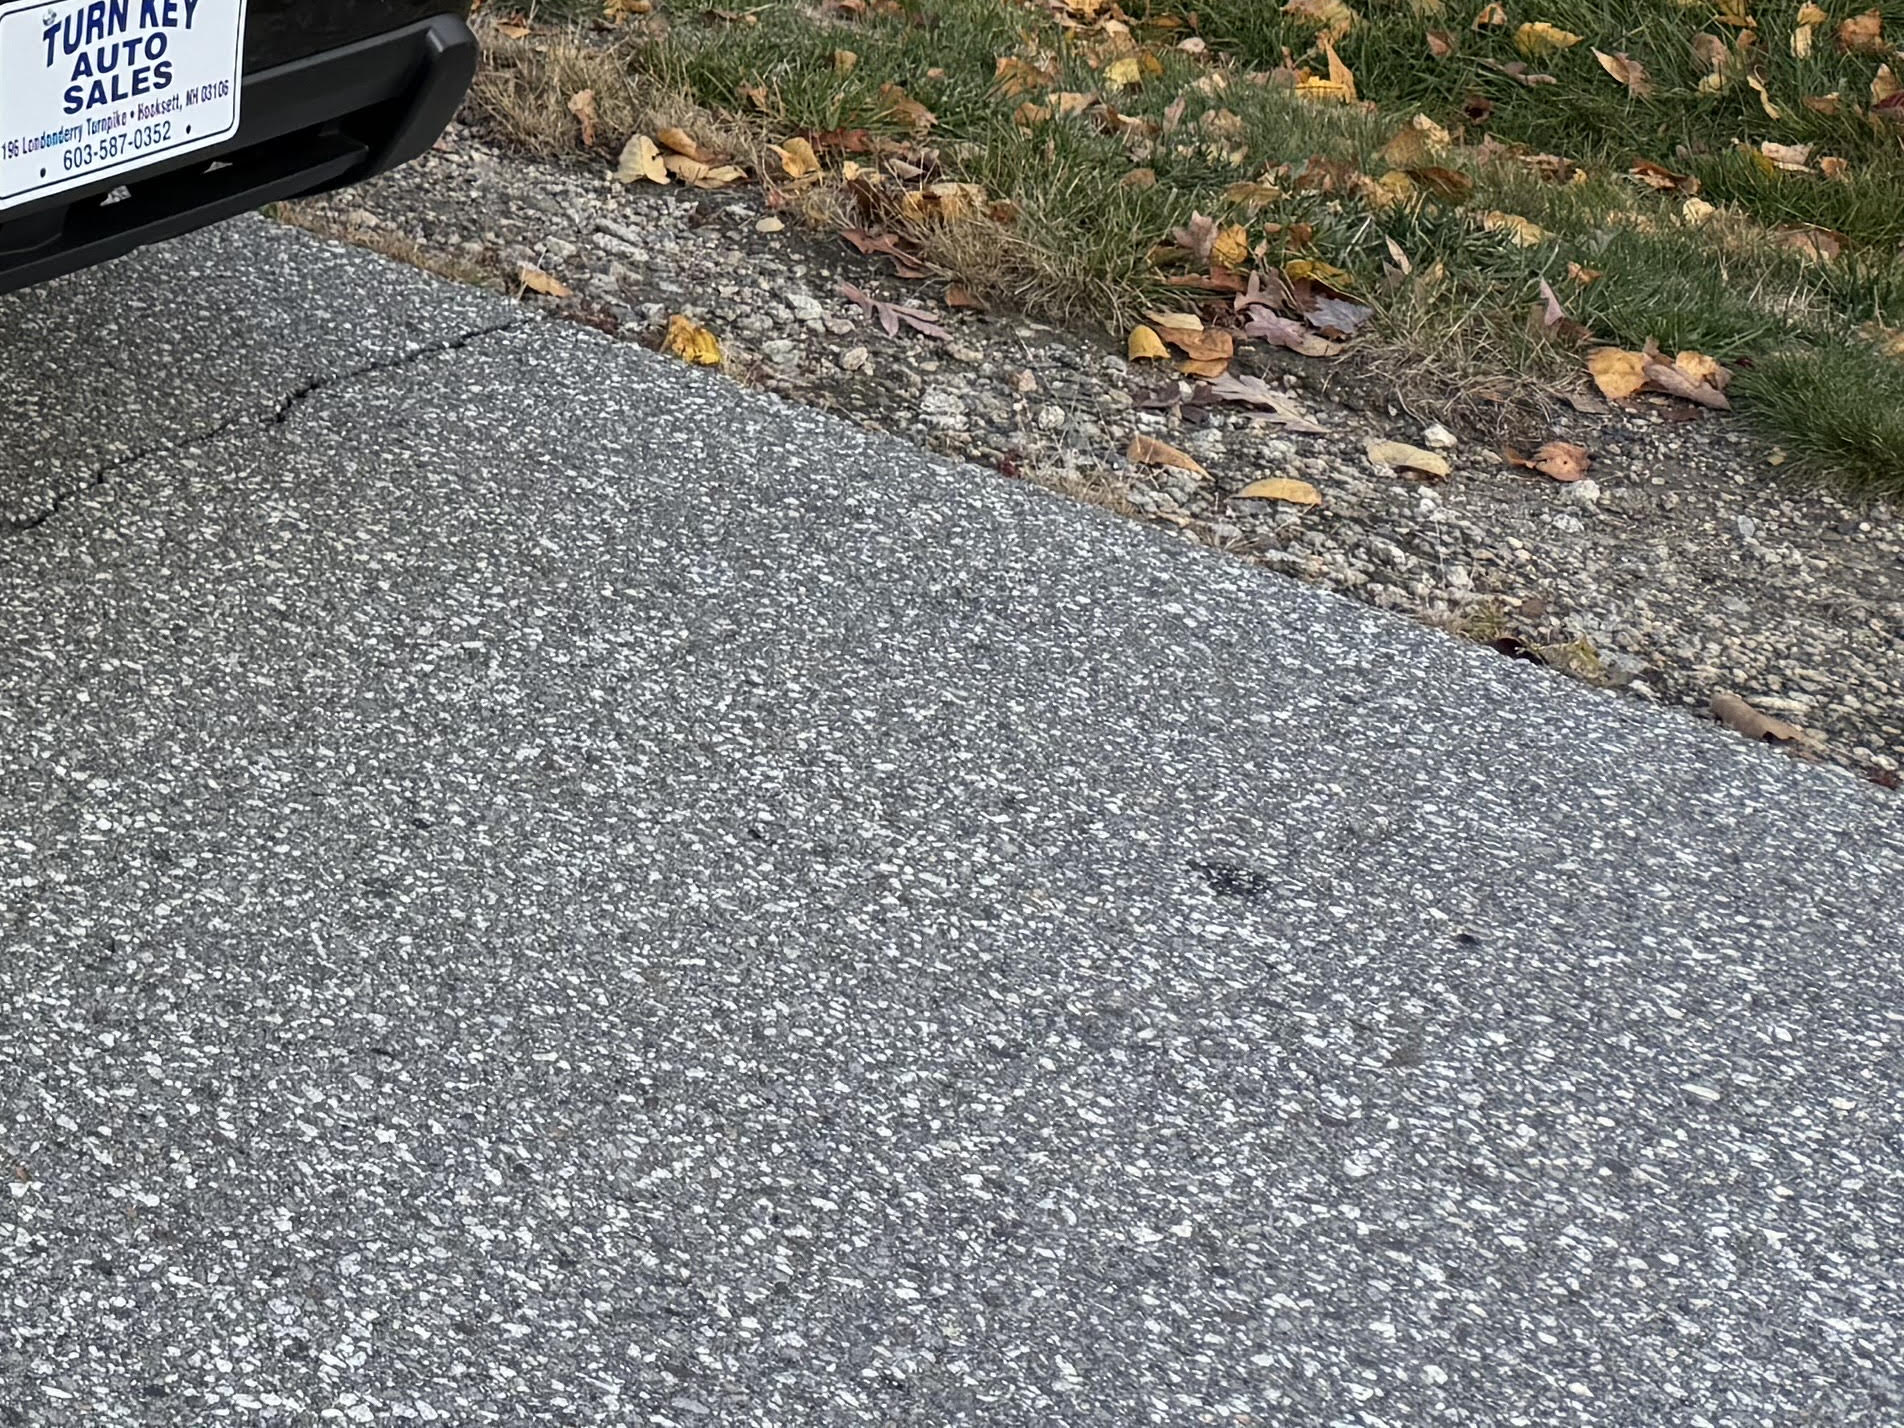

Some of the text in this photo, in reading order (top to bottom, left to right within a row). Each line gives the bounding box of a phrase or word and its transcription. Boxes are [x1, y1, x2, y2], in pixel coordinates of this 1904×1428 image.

[70, 31, 168, 82] AUTO
[63, 60, 173, 115] SALES
[21, 124, 84, 156] Londonderry
[86, 109, 128, 137] Turnpike
[137, 92, 183, 121] Hooksett,
[185, 87, 200, 107] NH
[63, 119, 172, 171] 603-587-0352
